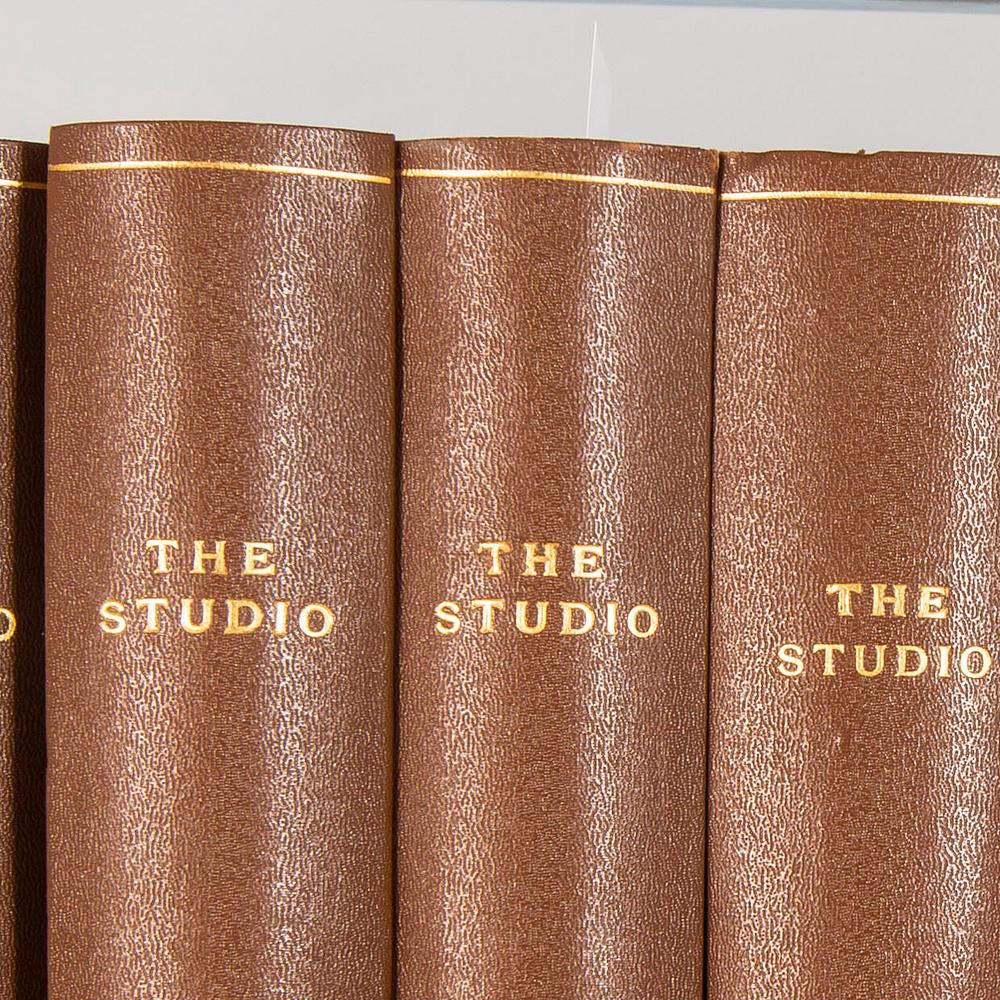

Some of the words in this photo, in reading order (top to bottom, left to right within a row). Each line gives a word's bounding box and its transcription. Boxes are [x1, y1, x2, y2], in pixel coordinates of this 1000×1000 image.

[147, 538, 277, 577] THE
[479, 541, 604, 577] THE
[100, 599, 335, 638] STUDIO
[435, 600, 659, 638] STUDIO
[826, 583, 949, 618] THE
[776, 644, 993, 679] STUDIO
